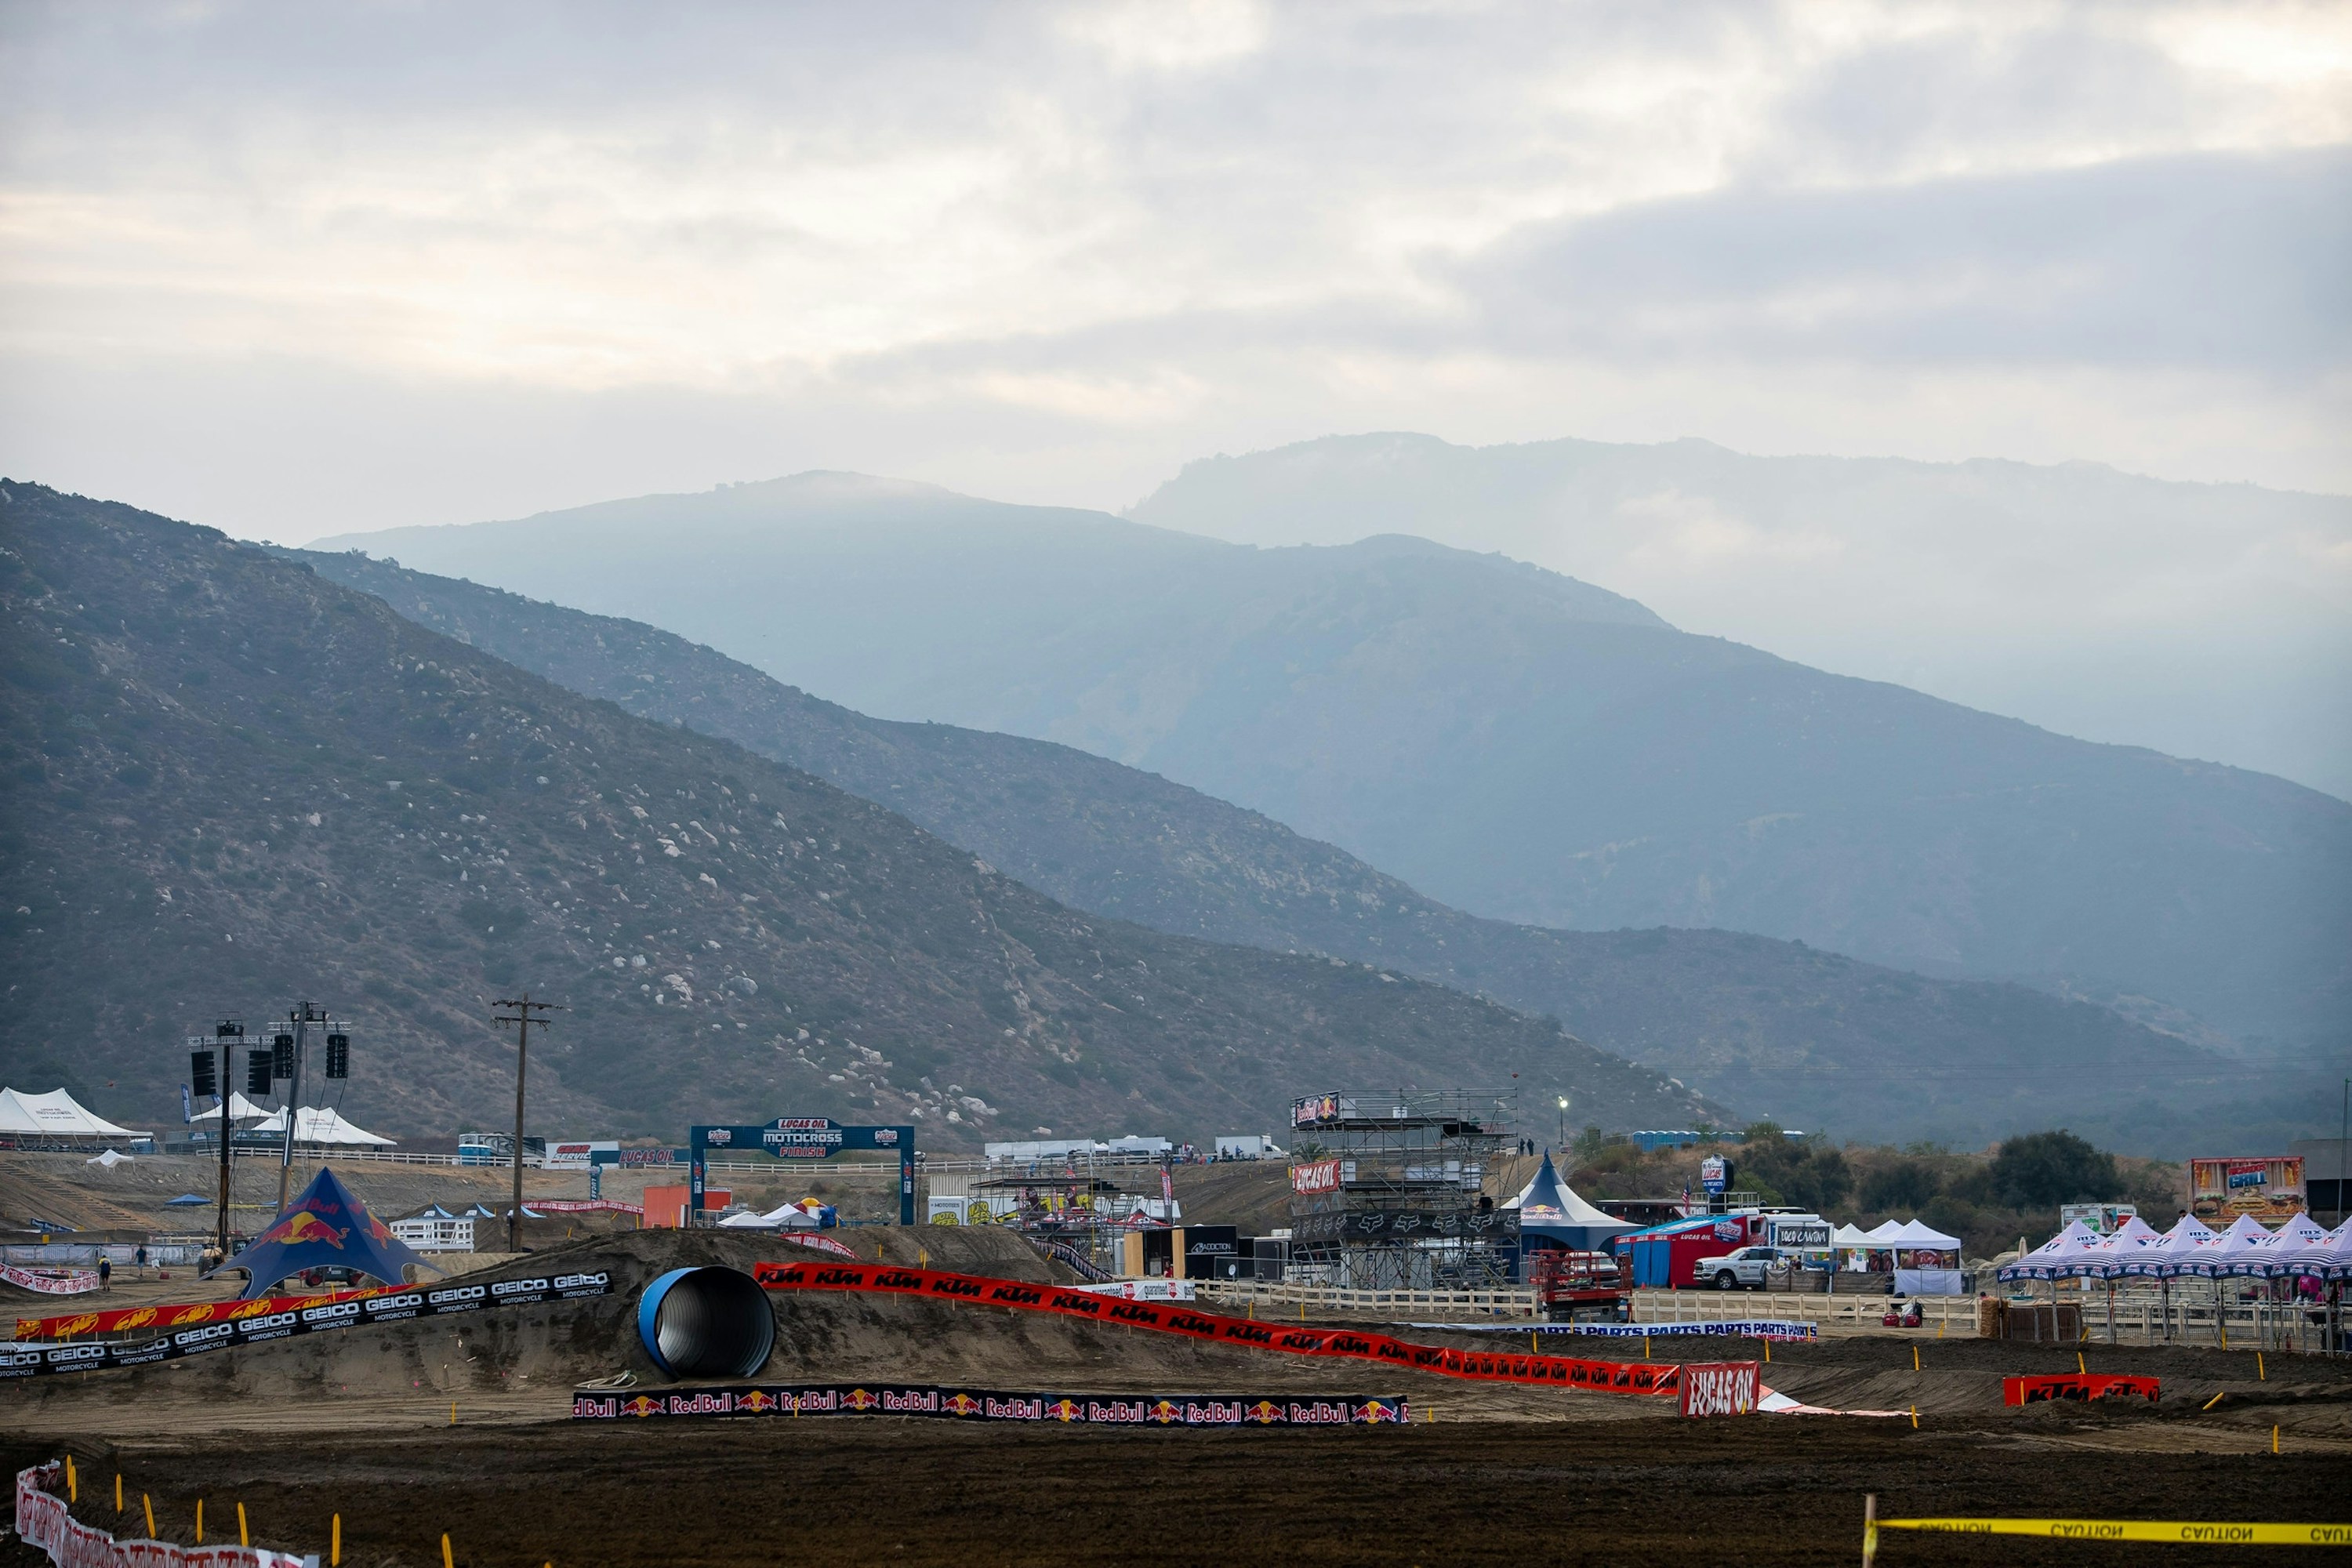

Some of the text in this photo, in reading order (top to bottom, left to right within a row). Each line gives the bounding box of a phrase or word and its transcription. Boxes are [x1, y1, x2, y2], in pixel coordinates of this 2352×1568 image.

[763, 1134, 842, 1142] MOTOCROSS
[557, 1145, 591, 1154] GEAR
[619, 1149, 675, 1163] LUCAS OIL
[779, 1146, 826, 1157] FINISH
[1297, 1163, 1335, 1191] LUCAS OIL
[2228, 1171, 2267, 1189] GRILL
[933, 1212, 956, 1221] MOTO
[1781, 1231, 1795, 1242] LOCO
[1145, 1283, 1167, 1298] guaranteed
[0, 1272, 608, 1367] EICO GEICO GEICO GEICO GEICO GEICO GEICO GEICO GEICO GEICO
[55, 1313, 98, 1337] FMF
[113, 1308, 156, 1331] FMF
[171, 1305, 213, 1324] FMF
[228, 1299, 270, 1319] FMF
[0, 1287, 604, 1378] OTORCYCLE MOTORCYCLE MOTORCYCLE MOTORCYCLE MOTORCYCLE MOTORCYCLE MOTORCYCLE MOTORCYCLE MOTORCYCLE MOTORCYCLE
[758, 1268, 804, 1283] KTM
[815, 1269, 863, 1286] KTM
[873, 1271, 924, 1289] KTM
[932, 1277, 982, 1298] KTM
[991, 1286, 1042, 1305] KTM
[1051, 1294, 1101, 1314] KTM
[1110, 1303, 1160, 1323] KTM
[1168, 1314, 1215, 1334] KTM
[1225, 1323, 1273, 1343] KTM
[1281, 1333, 1323, 1350] KTM
[1333, 1335, 1370, 1354] KTM
[1378, 1341, 1410, 1361] KTM
[1415, 1350, 1443, 1367] KTM
[1446, 1355, 1461, 1372] KTM
[1463, 1358, 1478, 1374] KTM
[1480, 1358, 1494, 1374] KTM
[1497, 1359, 1510, 1376] KTM
[1513, 1361, 1528, 1377] KTM
[1531, 1361, 1548, 1379] KTM
[1551, 1363, 1567, 1381] KTM
[1570, 1365, 1588, 1382] KTM
[1591, 1367, 1609, 1385] KTM
[1613, 1370, 1630, 1388] KTM
[1634, 1371, 1653, 1389] KTM
[1586, 1327, 1643, 1336] PARTS
[1648, 1325, 1700, 1336] PARTS
[1704, 1323, 1751, 1336] PARTS
[1755, 1323, 1787, 1334] PARTS
[1788, 1325, 1817, 1337] PARTS
[1687, 1368, 1755, 1416] LUCAS OIL
[2027, 1382, 2089, 1402] KTM
[585, 1398, 616, 1417] Bull
[670, 1396, 700, 1414] Red
[701, 1392, 731, 1413] Bull
[781, 1391, 808, 1410] Red
[808, 1390, 837, 1410] Bull
[883, 1390, 910, 1410] Red
[910, 1391, 938, 1411] Bull
[986, 1397, 1014, 1417] Red
[1014, 1399, 1041, 1419] Bull
[1089, 1402, 1117, 1422] Red
[1117, 1402, 1144, 1422] Bull
[1187, 1402, 1214, 1422] Red
[1215, 1402, 1241, 1423] Bull
[1290, 1403, 1319, 1423] Red
[1320, 1403, 1349, 1424] Bull
